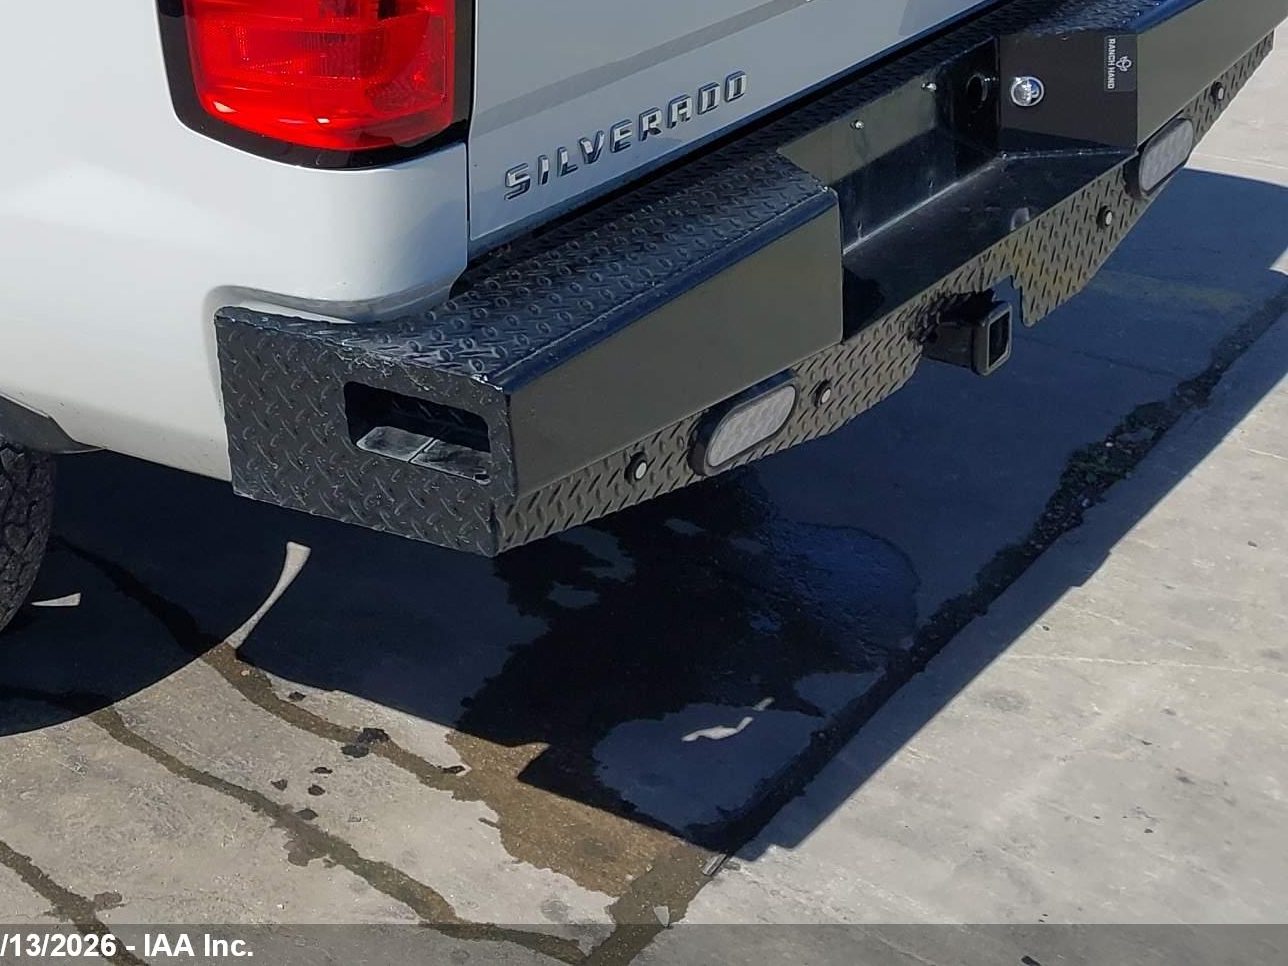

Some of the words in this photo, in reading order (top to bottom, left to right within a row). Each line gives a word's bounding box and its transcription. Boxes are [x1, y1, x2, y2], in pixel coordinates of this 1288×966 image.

[1107, 38, 1116, 66] RANCH
[1107, 67, 1115, 89] HAND
[503, 70, 748, 201] SILVERADO
